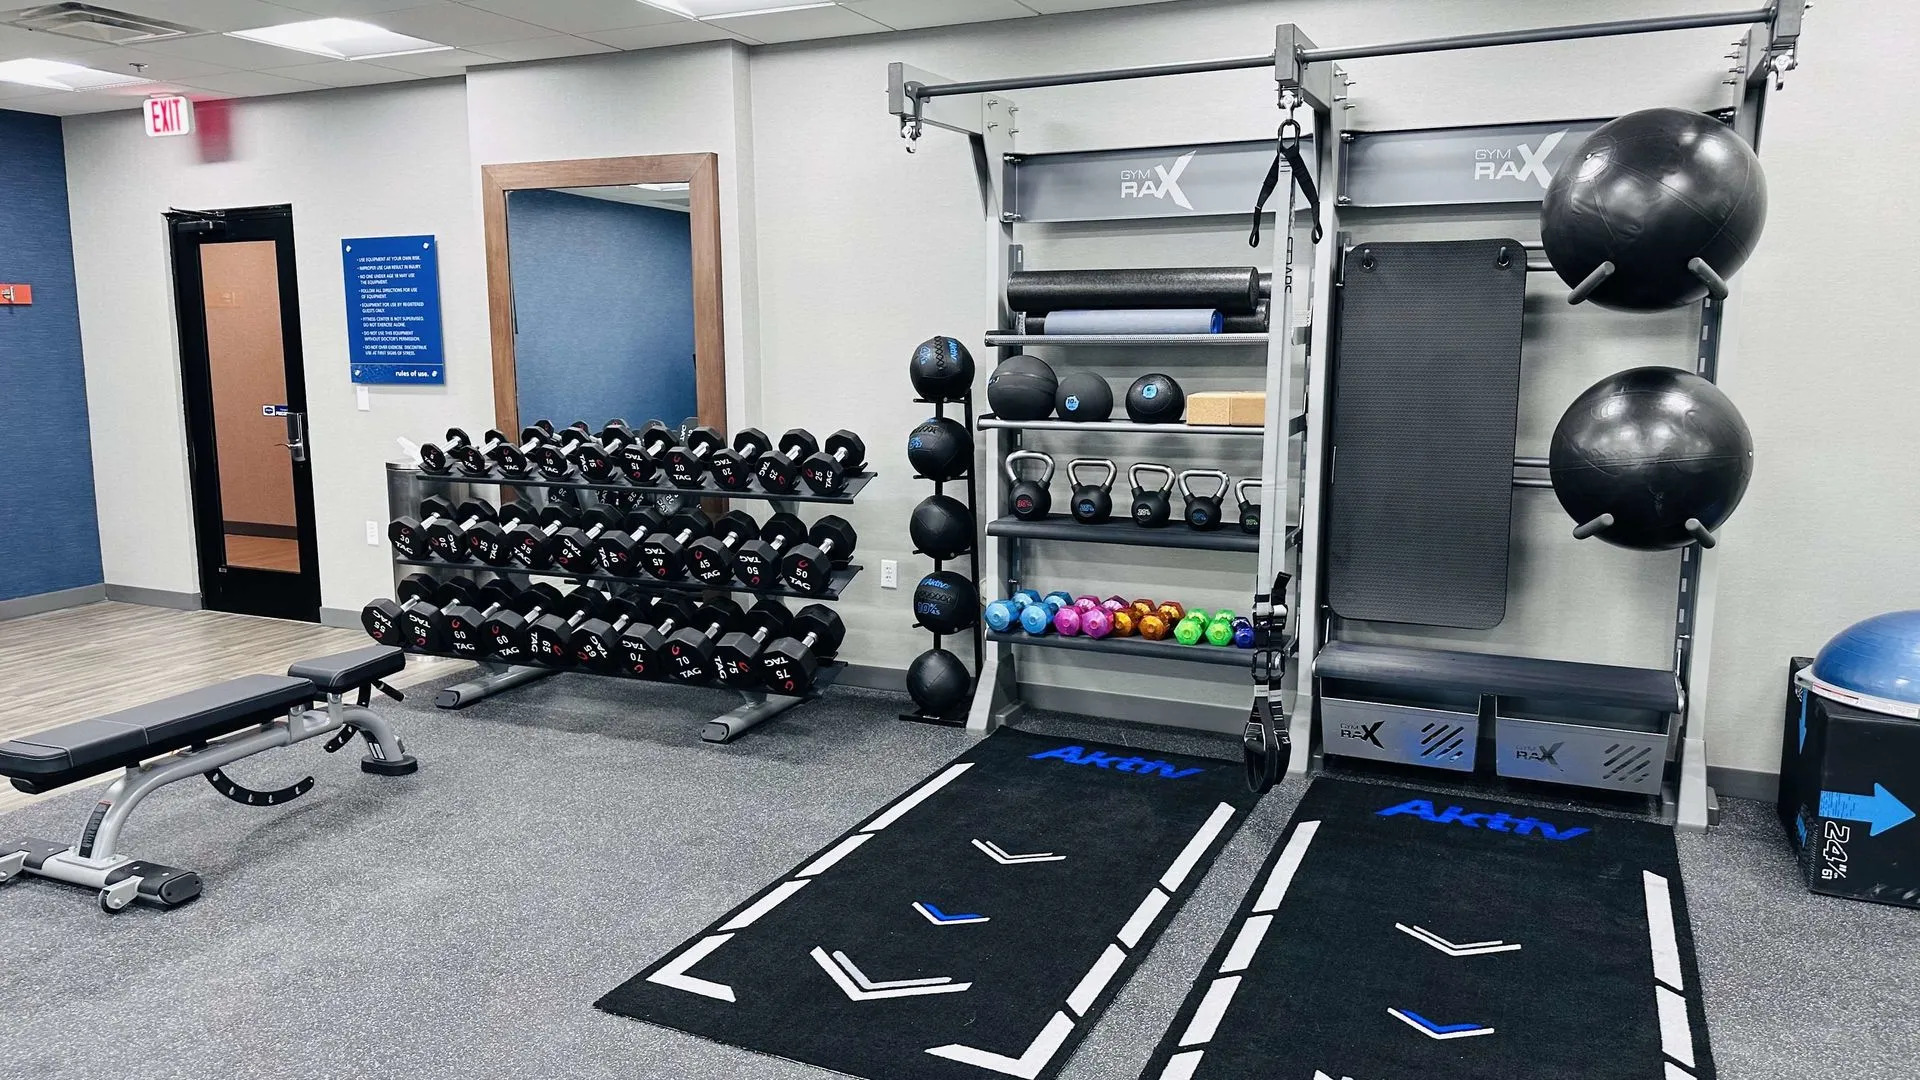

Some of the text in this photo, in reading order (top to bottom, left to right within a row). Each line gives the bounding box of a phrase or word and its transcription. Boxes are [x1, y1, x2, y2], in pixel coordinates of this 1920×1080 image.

[151, 100, 180, 132] EXIT
[1474, 128, 1569, 190] RAX
[1475, 148, 1511, 160] GYM
[1120, 168, 1151, 180] GYM
[1120, 150, 1197, 211] RAX
[624, 452, 642, 461] TAG
[714, 458, 732, 466] TAG
[580, 454, 588, 472] TAG
[588, 459, 596, 468] 15
[632, 462, 640, 470] 15
[758, 462, 770, 476] TAG
[722, 468, 732, 476] 20
[769, 470, 778, 480] 25
[815, 470, 823, 482] 25
[825, 470, 834, 488] TAG
[400, 534, 410, 544] 30
[439, 538, 448, 548] 30
[448, 534, 458, 554] TAG
[394, 541, 414, 555] TAG
[480, 540, 488, 552] 35
[490, 542, 498, 560] TAG
[520, 544, 532, 554] 35
[564, 539, 582, 556] TAG
[514, 547, 532, 564] TAG
[562, 548, 574, 558] 40
[598, 547, 610, 568] TAG
[609, 552, 619, 563] 40
[652, 558, 664, 566] 45
[700, 560, 710, 568] 45
[739, 556, 762, 564] TAG
[700, 570, 720, 580] TAG
[747, 566, 758, 575] 50
[796, 568, 808, 578] 50
[789, 576, 811, 590] TAG
[372, 610, 392, 628] TAG
[408, 614, 430, 628] TAG
[374, 622, 386, 633] 55
[414, 626, 426, 638] 55
[454, 630, 466, 640] 60
[496, 636, 508, 645] 60
[454, 642, 475, 650] TAG
[530, 632, 538, 652] TAG
[542, 640, 552, 654] 65
[590, 636, 608, 658] TAG
[622, 640, 646, 651] TAG
[499, 646, 520, 656] TAG
[583, 645, 597, 658] 65
[630, 652, 644, 662] 70
[676, 656, 690, 666] 70
[764, 656, 788, 666] TAG
[680, 667, 702, 678] TAG
[714, 656, 728, 680] TAG
[727, 661, 740, 674] 75
[776, 668, 790, 679] 75
[1341, 720, 1385, 750] RAX
[1028, 745, 1207, 779] Aktiv
[1375, 799, 1592, 841] Aktiv
